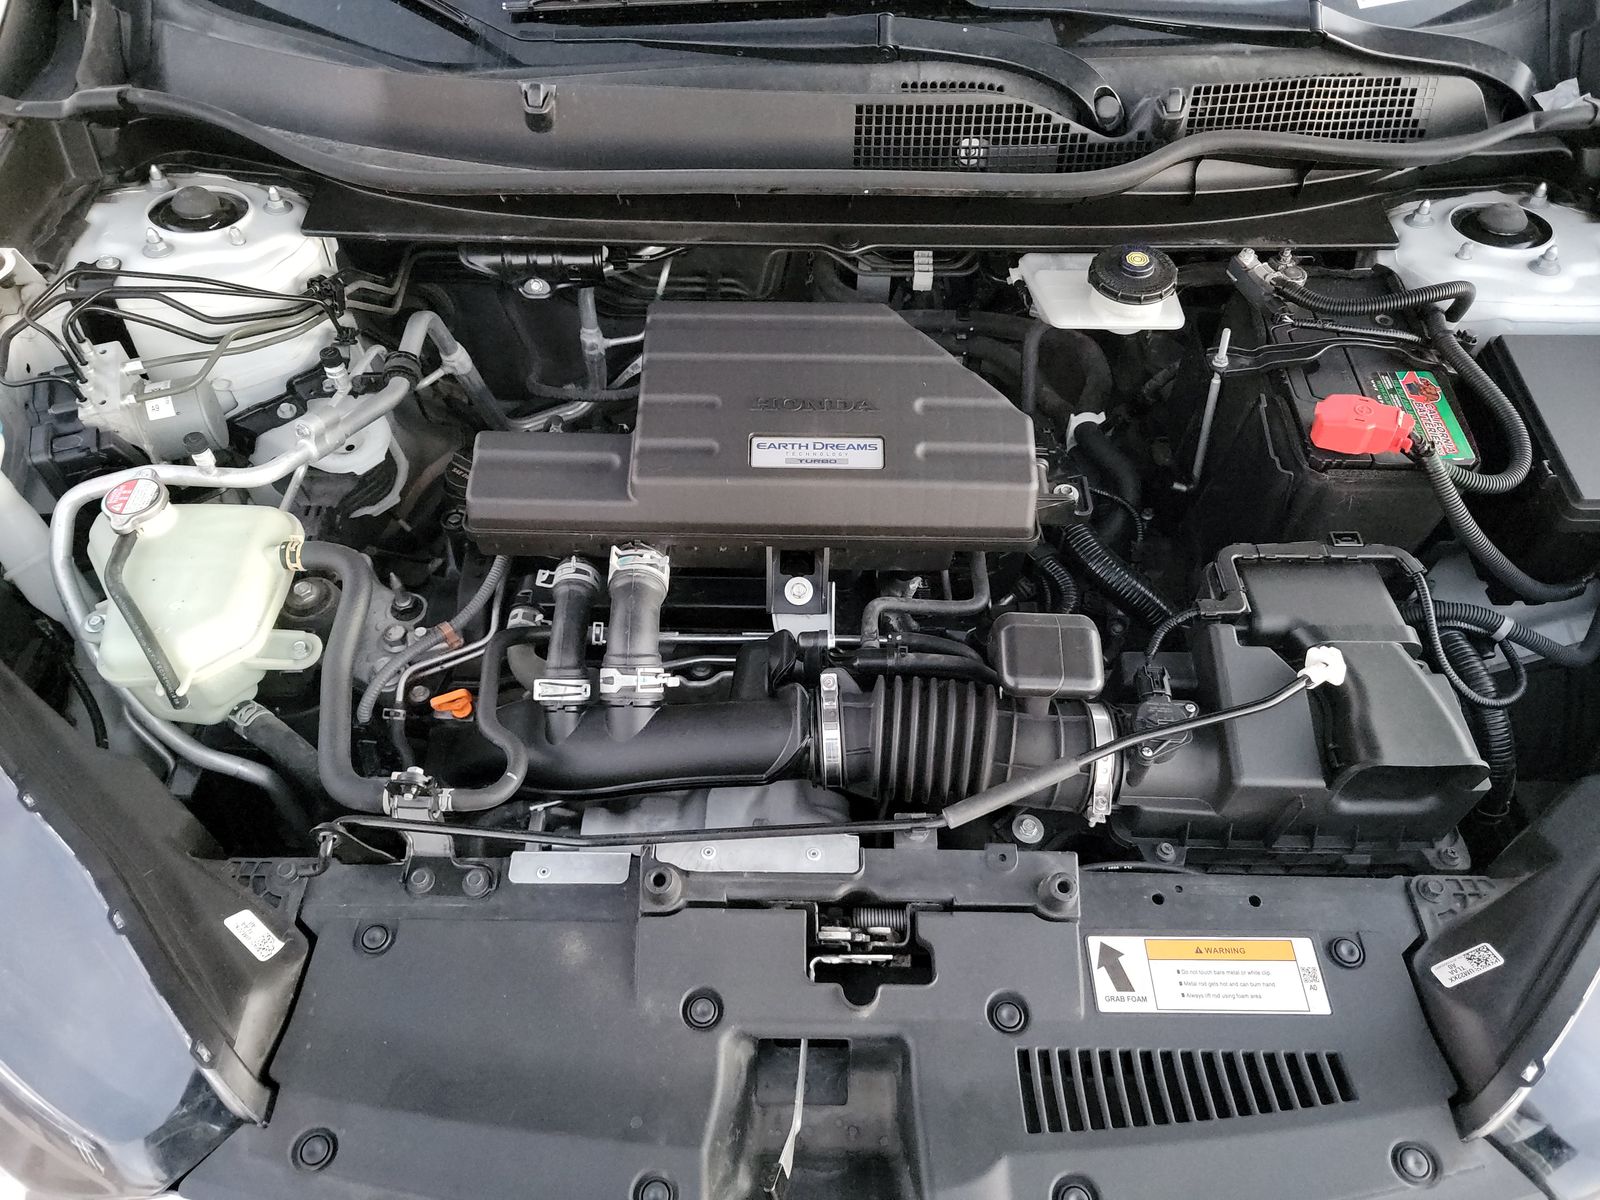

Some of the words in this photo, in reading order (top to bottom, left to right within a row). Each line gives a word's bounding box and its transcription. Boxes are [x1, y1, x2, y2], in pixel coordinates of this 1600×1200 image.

[750, 397, 880, 412] HONDA
[1415, 402, 1443, 445] BATTERIES
[1424, 403, 1456, 453] CALIFORNIA
[756, 442, 809, 450] EARTH
[813, 441, 878, 451] DREAMS
[1204, 947, 1246, 955] WARNING
[1104, 995, 1126, 1003] GRAB
[1127, 995, 1148, 1003] FOAM
